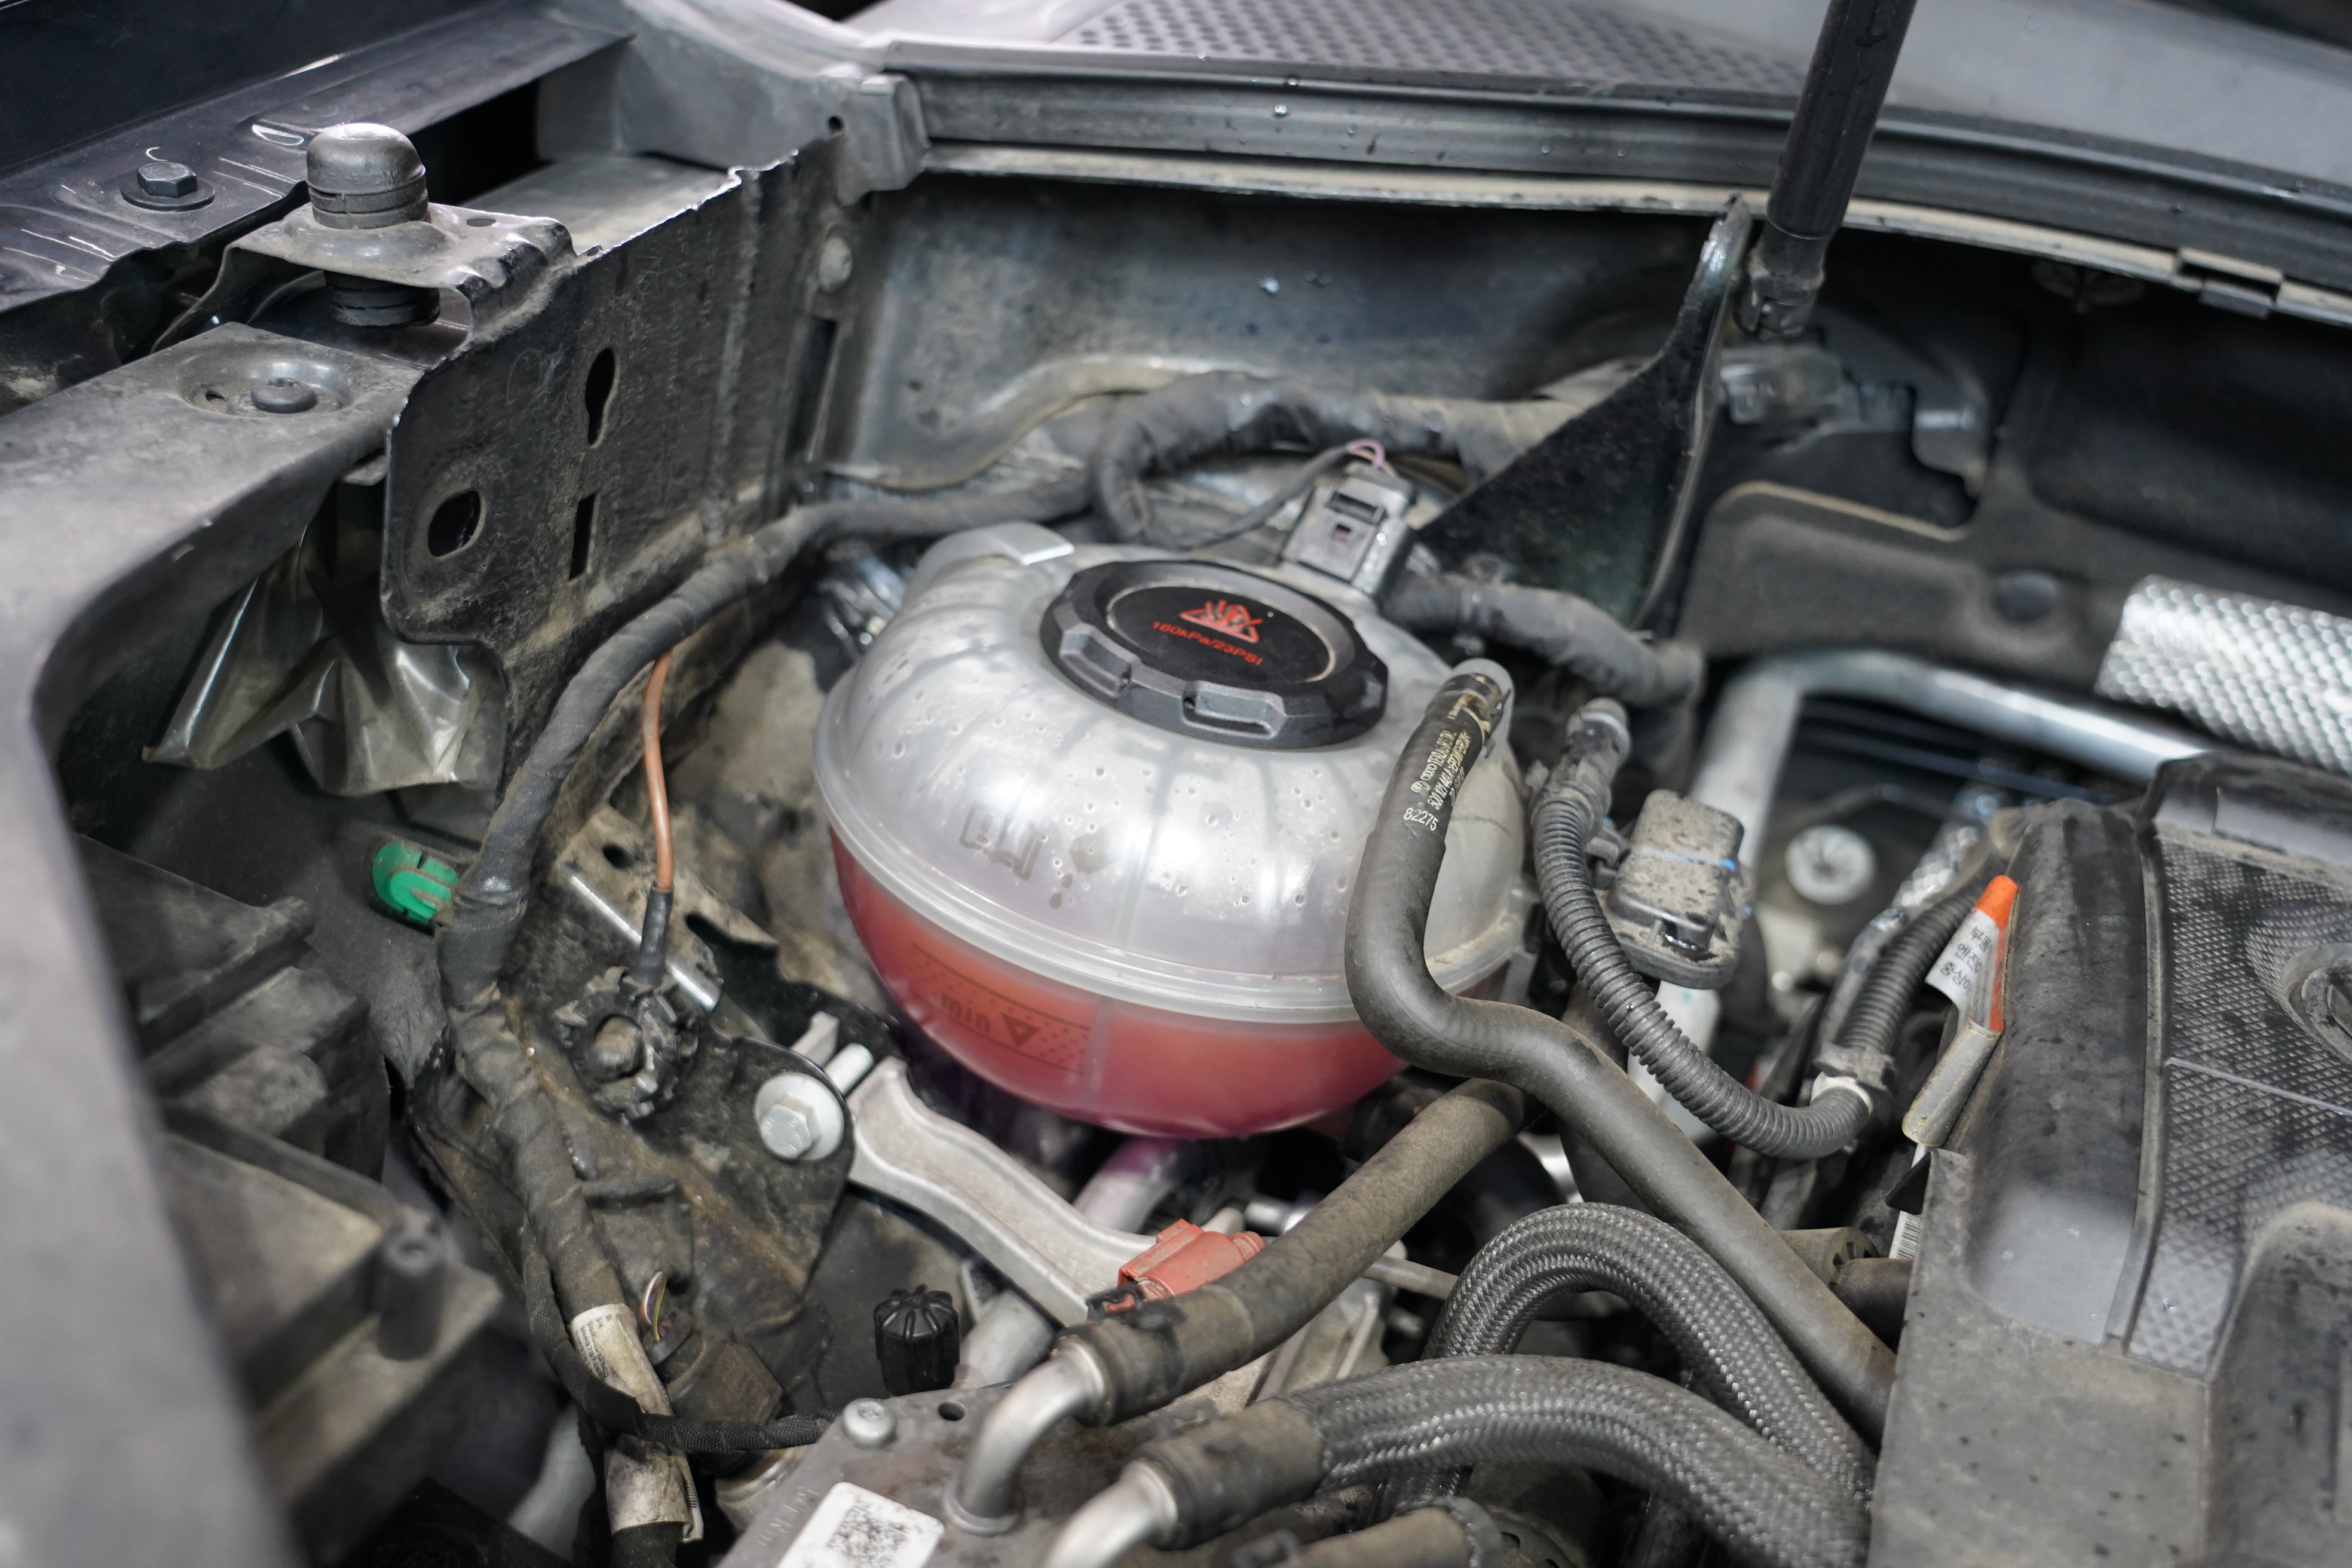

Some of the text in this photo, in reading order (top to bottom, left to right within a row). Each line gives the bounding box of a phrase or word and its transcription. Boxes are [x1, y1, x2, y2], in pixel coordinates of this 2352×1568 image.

[1434, 782, 1448, 798] 121
[1404, 808, 1438, 831] 82275
[942, 994, 990, 1033] min
